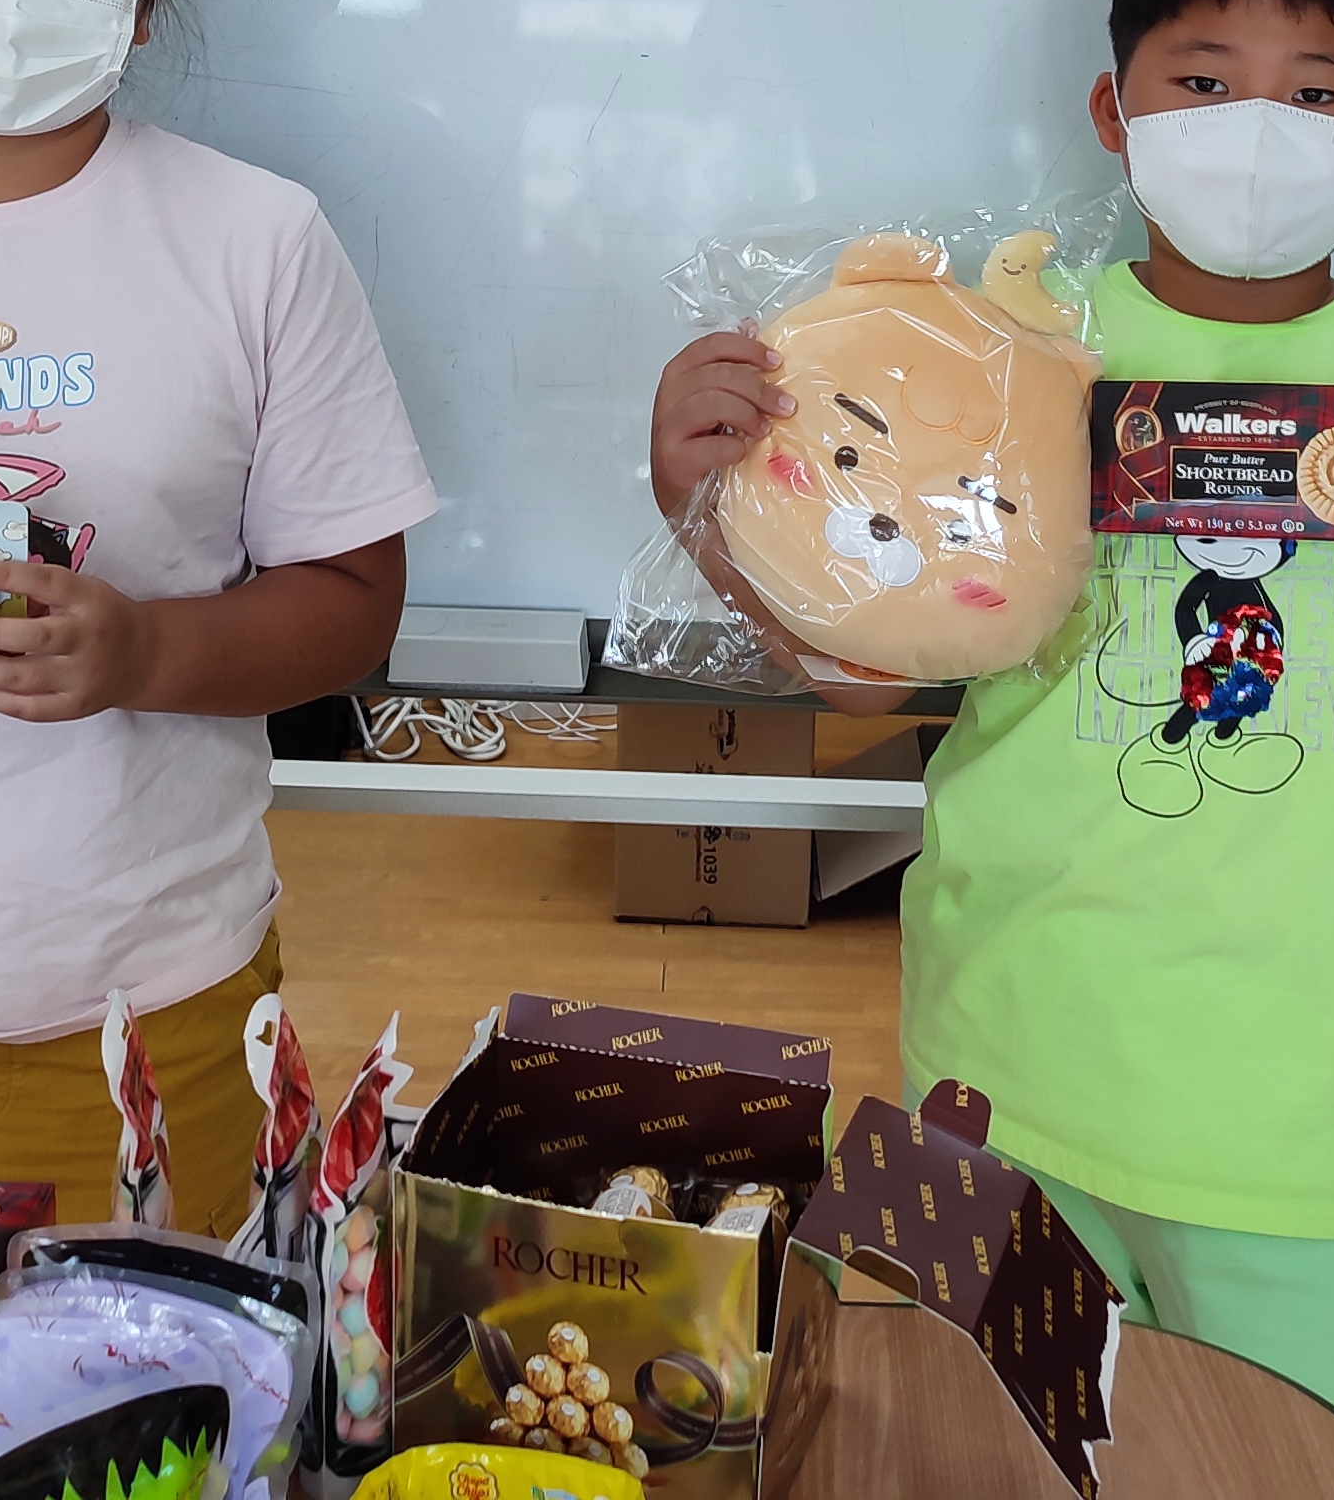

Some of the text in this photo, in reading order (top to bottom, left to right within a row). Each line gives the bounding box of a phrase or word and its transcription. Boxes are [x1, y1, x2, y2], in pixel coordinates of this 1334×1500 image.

[1174, 411, 1297, 437] Walkers
[1204, 453, 1267, 467] Pure Butter
[1175, 463, 1295, 484] SHORTBREAD
[1203, 480, 1264, 496] ROUNDS
[703, 846, 718, 885] 1039
[551, 999, 598, 1018] ROCH
[612, 1026, 664, 1051] ROCHER
[781, 1036, 833, 1060] ROCHER
[511, 1051, 560, 1071] ROCHER
[674, 1060, 725, 1083] ROCHER
[575, 1082, 624, 1102] ROCHER
[741, 1094, 792, 1115] ROCHER
[640, 1114, 690, 1135] ROCHER
[540, 1134, 589, 1156] ROCHER
[704, 1146, 755, 1167] ROCHER
[492, 1235, 648, 1296] ROCHER
